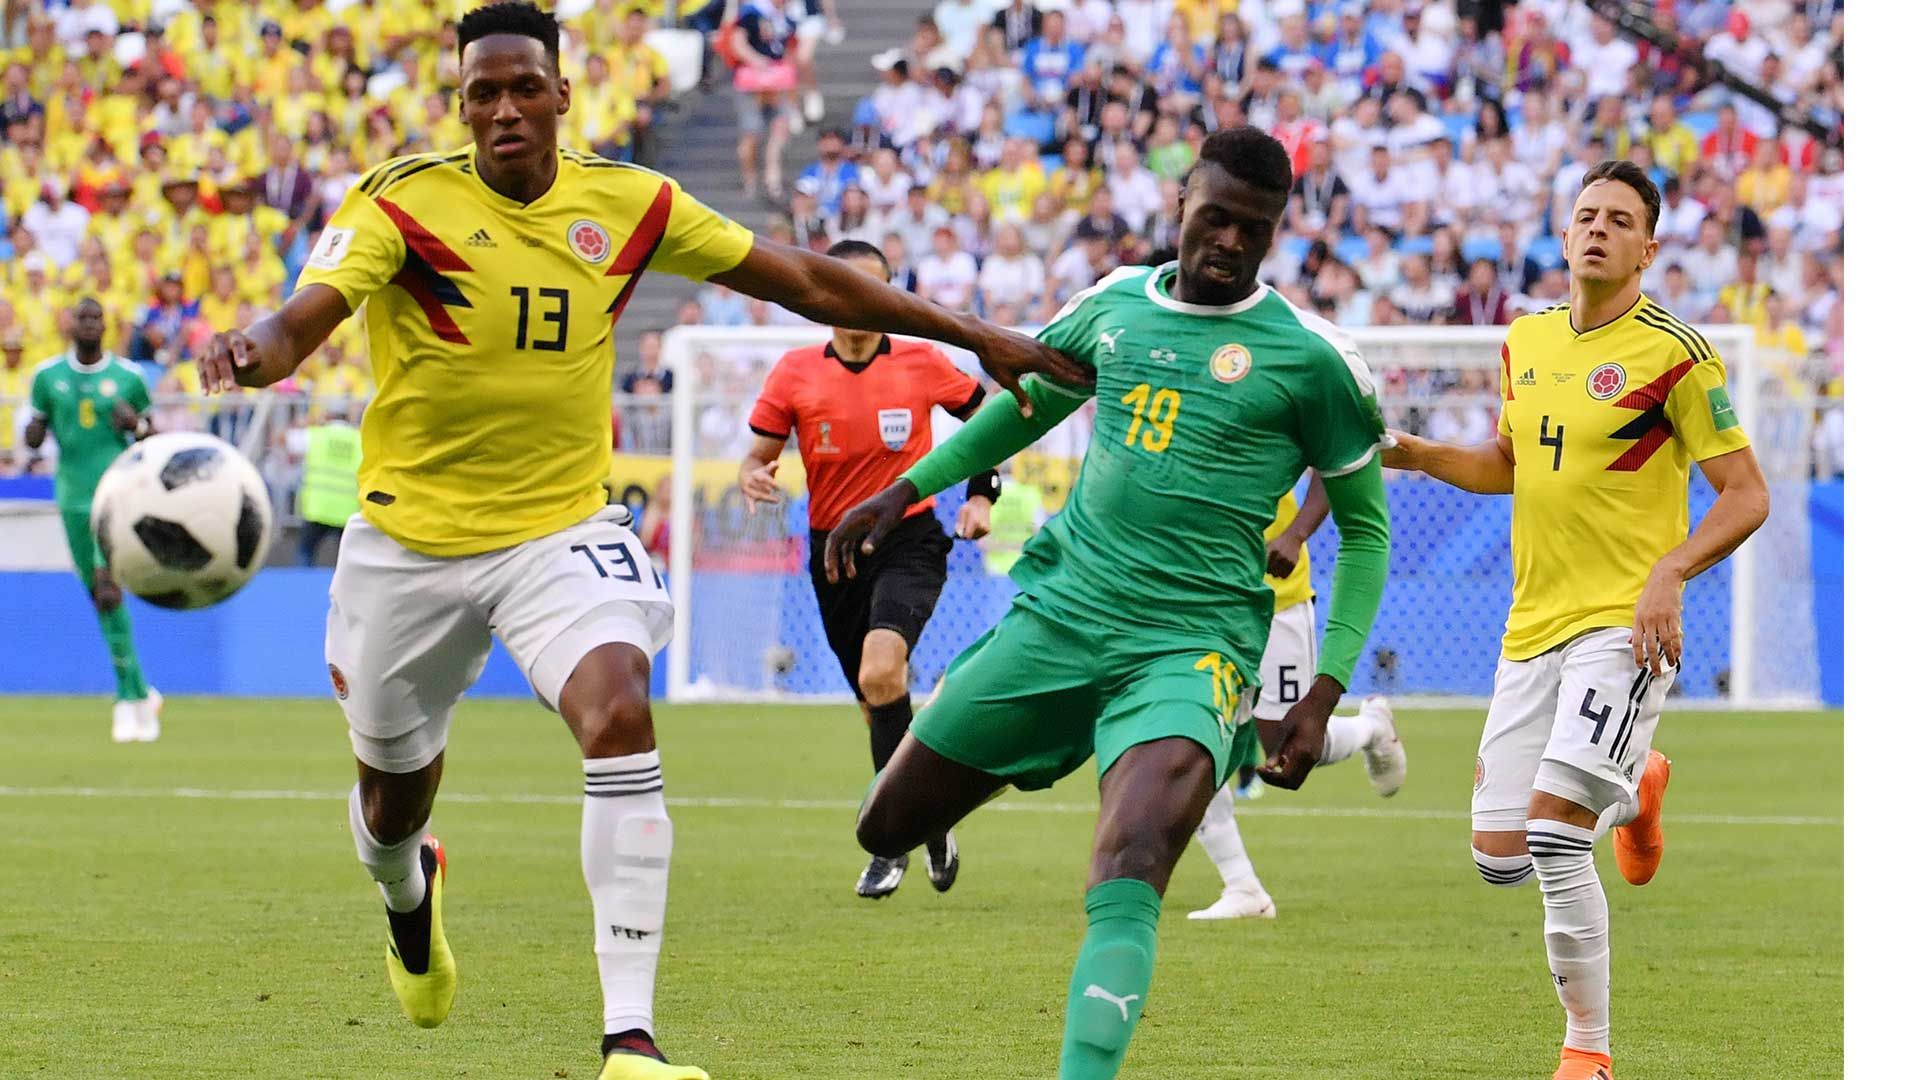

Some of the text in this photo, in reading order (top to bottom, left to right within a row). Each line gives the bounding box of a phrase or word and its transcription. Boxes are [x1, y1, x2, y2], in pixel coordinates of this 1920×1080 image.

[510, 286, 570, 352] 13
[884, 425, 906, 433] FIFA
[1121, 384, 1181, 452] 19
[1540, 415, 1564, 471] 4
[570, 542, 642, 583] 13
[1279, 665, 1300, 702] 6
[1579, 687, 1613, 745] 4
